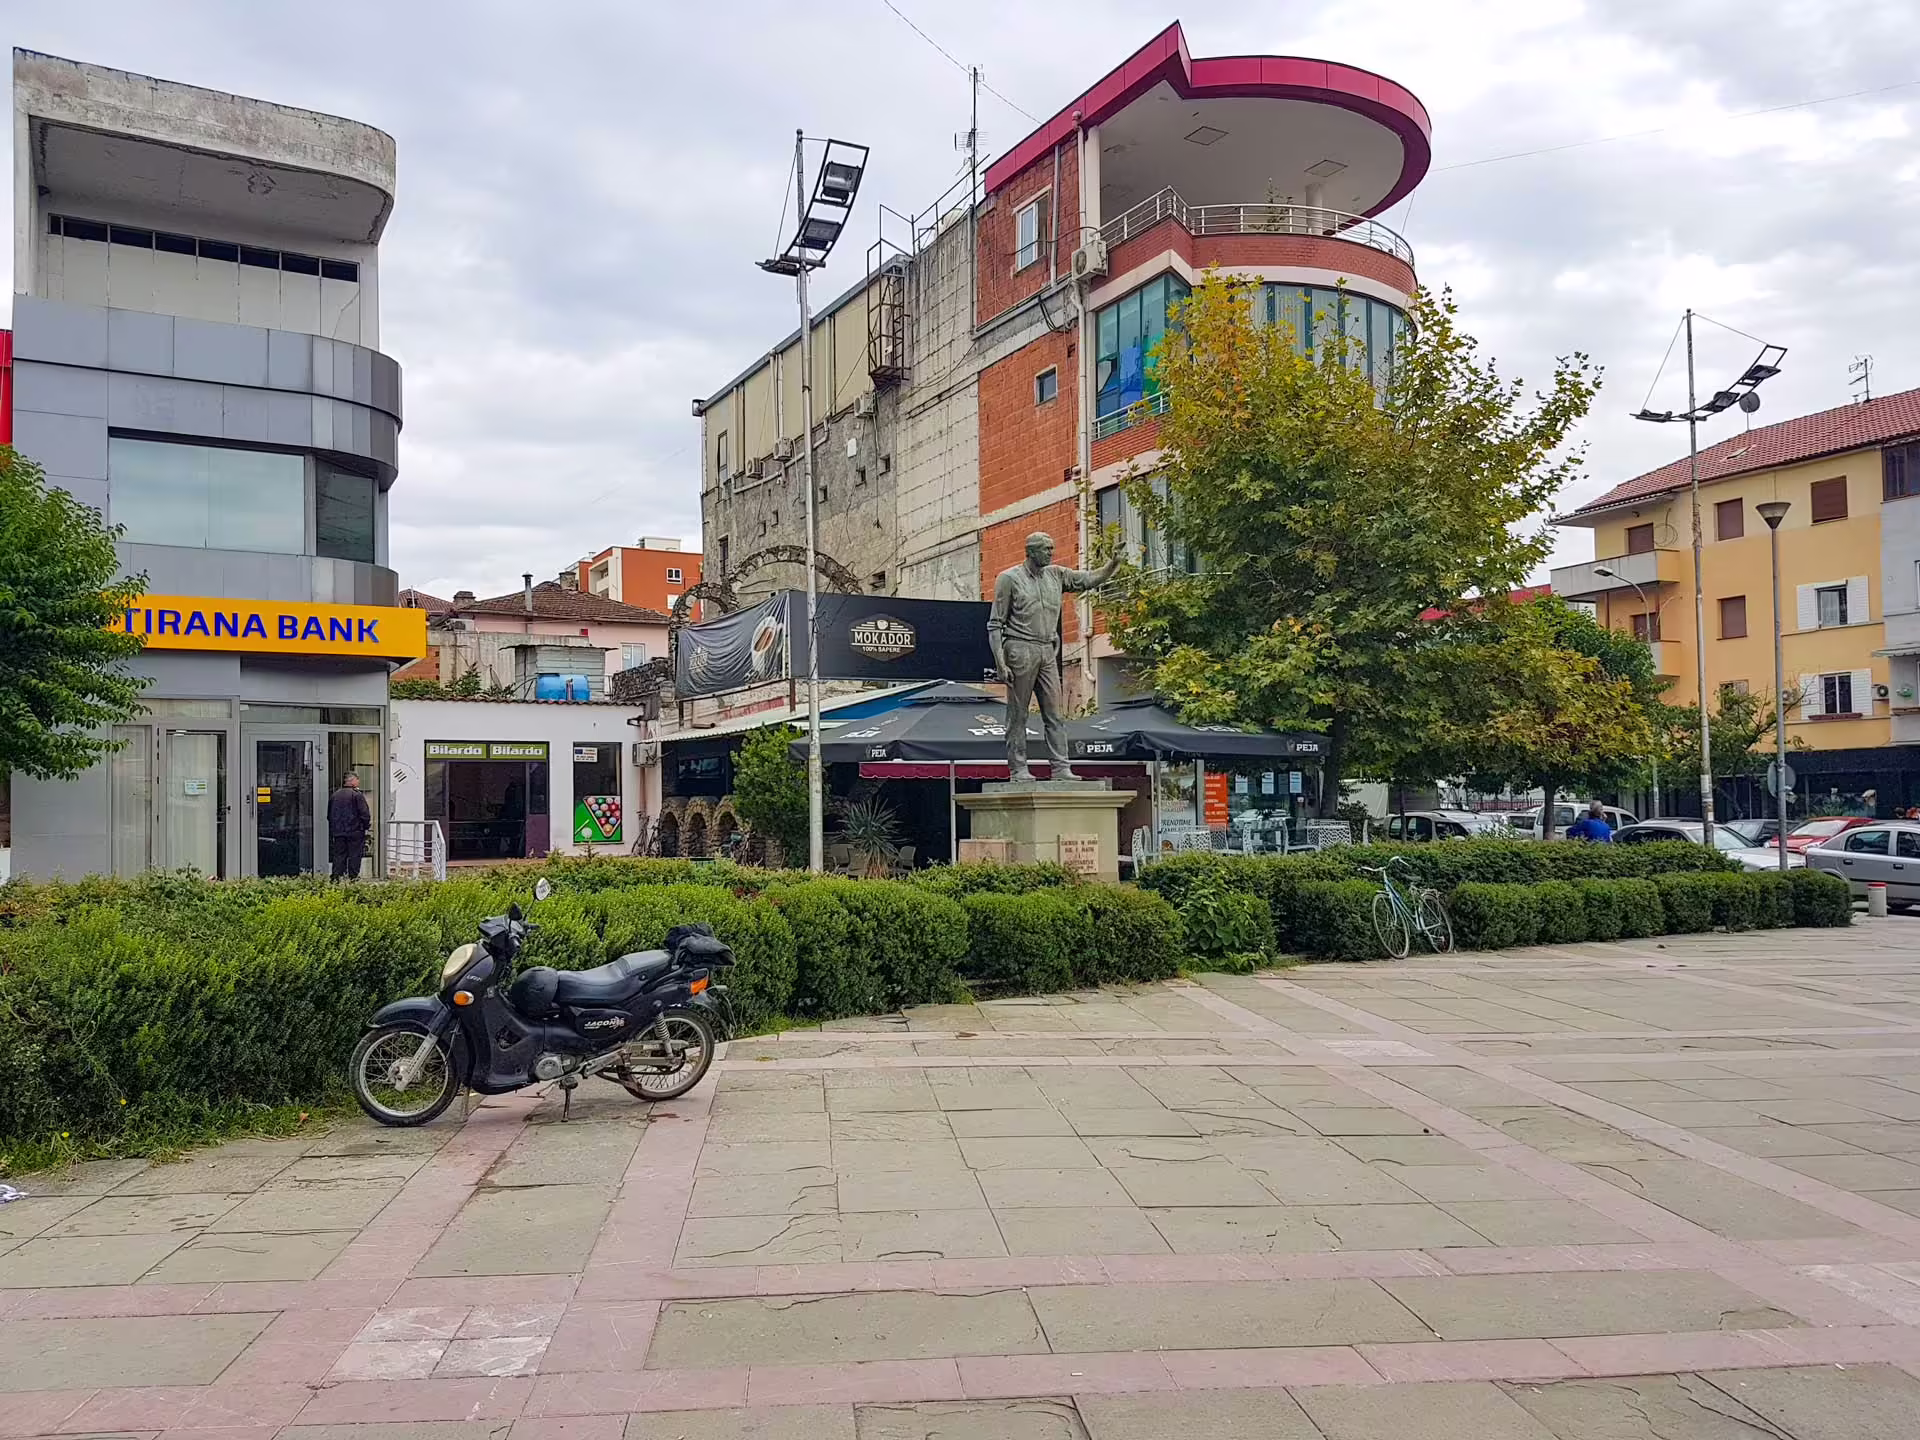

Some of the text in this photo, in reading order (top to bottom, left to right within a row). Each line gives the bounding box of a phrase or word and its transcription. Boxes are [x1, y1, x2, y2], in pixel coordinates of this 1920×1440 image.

[125, 607, 381, 644] TIRANA BANK
[854, 631, 912, 645] MOKADOR
[967, 727, 1040, 736] PEA
[429, 745, 482, 755] Bilardo
[492, 745, 543, 755] Bilardo
[1086, 744, 1114, 753] PEJA
[1296, 743, 1319, 752] PEJA
